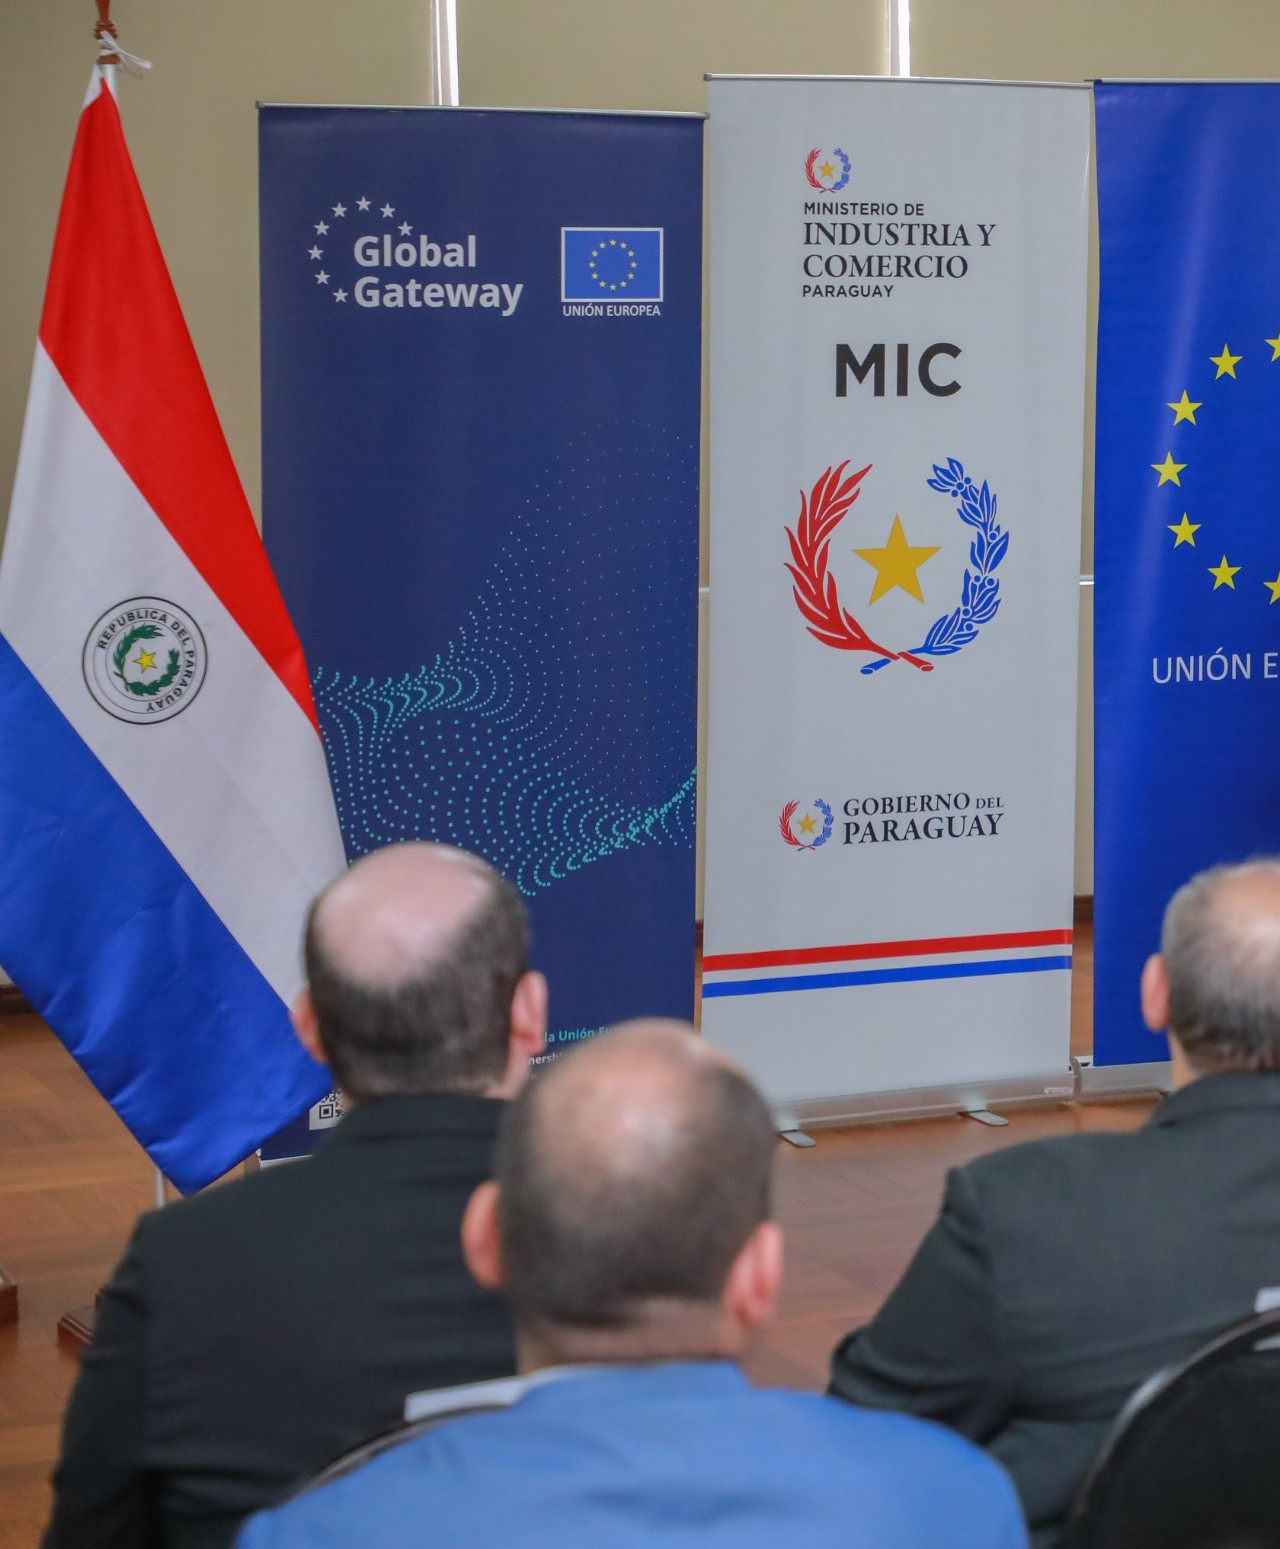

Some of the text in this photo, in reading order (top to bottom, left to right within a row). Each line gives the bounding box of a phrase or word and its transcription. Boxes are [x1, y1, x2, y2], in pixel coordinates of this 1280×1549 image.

[803, 202, 925, 216] MINISTERIO DE
[803, 222, 997, 247] INDUSTRIA Y
[353, 234, 477, 268] Global
[803, 254, 969, 278] COMERCIO
[353, 276, 524, 317] Gateway
[802, 285, 894, 298] PARAGUAY
[562, 302, 661, 317] UNIÓN EUROPEA
[836, 342, 962, 398] MIC
[98, 610, 194, 712] REPUBLICA DEL PARAGUAY
[1152, 646, 1250, 684] UNIÓN
[843, 792, 1004, 816] GOBIERNO DEL
[842, 812, 1004, 844] PARAGUAY
[558, 1027, 595, 1042] Unión
